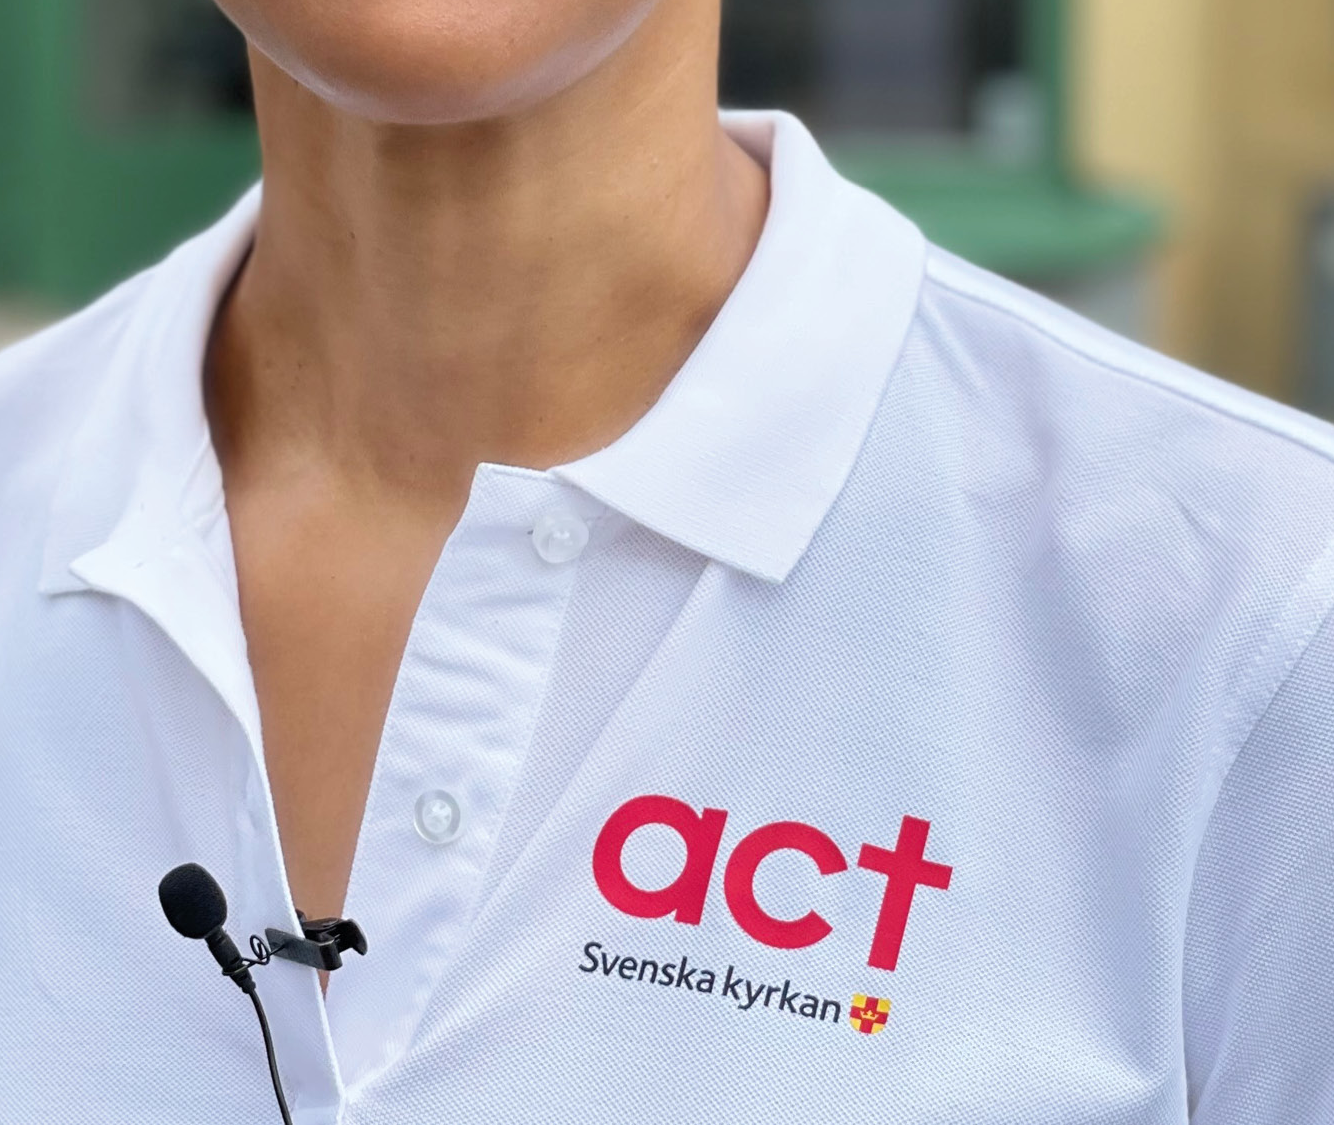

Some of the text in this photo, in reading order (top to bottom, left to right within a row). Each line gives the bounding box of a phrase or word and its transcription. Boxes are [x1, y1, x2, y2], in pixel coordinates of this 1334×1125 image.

[592, 794, 953, 972] act
[578, 941, 842, 1024] Svenska kyrkan
